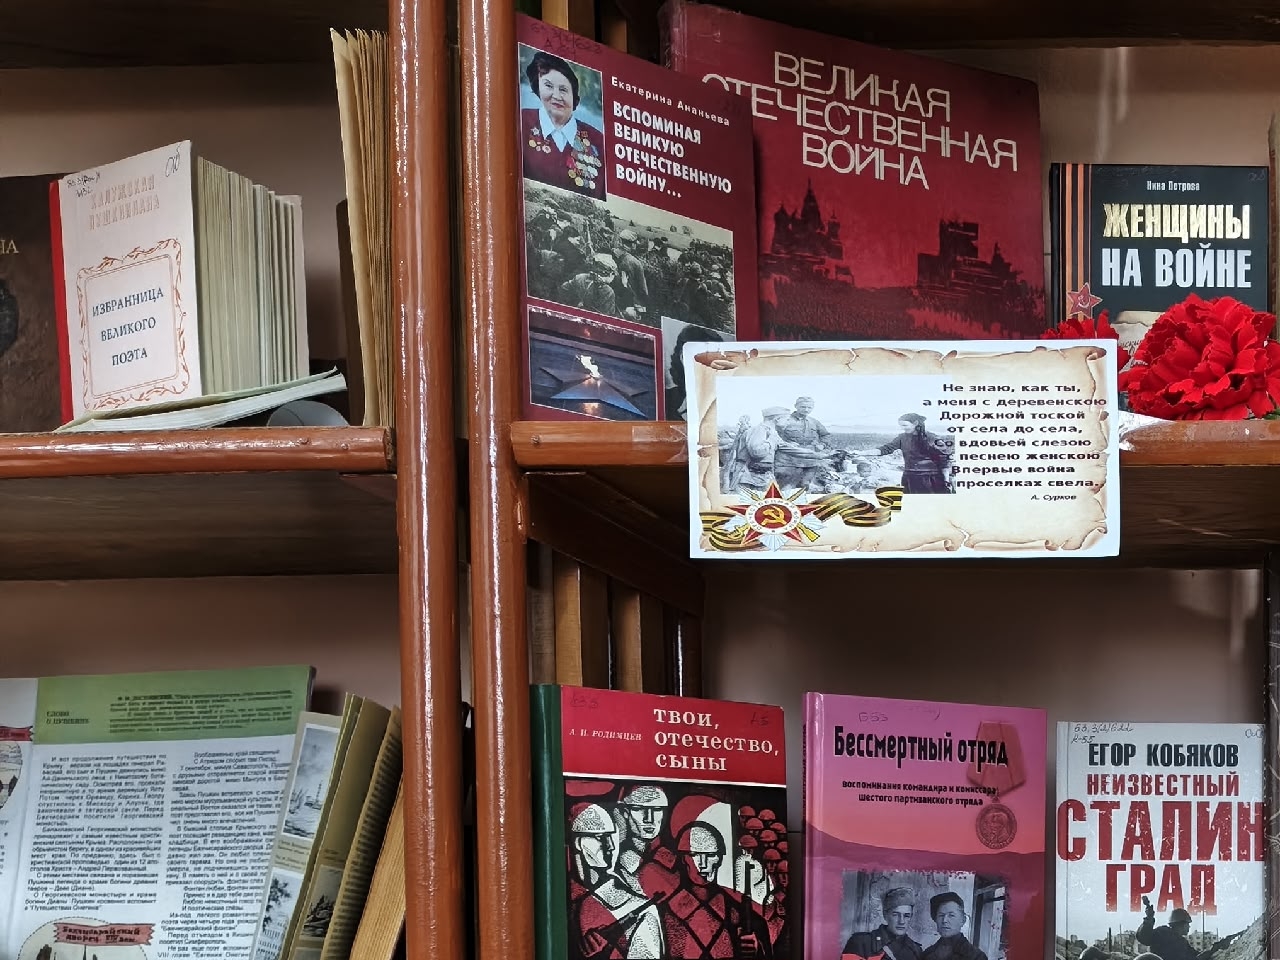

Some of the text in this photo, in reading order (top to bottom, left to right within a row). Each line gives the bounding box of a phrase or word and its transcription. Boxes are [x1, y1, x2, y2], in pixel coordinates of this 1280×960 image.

[774, 51, 950, 122] ВЕЛИКАЯ
[611, 76, 730, 126] Екатерина Ананьева
[613, 101, 702, 144] ВСПОМИНАЯ
[614, 122, 685, 158] ВЕЛИКУЮ
[614, 143, 732, 193] ОТЕЧЕСТВЕННУЮ
[803, 131, 930, 190] ВОЙНА
[1146, 180, 1201, 192] Нина Петрова
[1103, 202, 1251, 243] ЖЕНЩИНЫ
[1101, 243, 1252, 289] НА ВОЙНЕ
[92, 286, 164, 317] ИЗБРАННИЦА
[100, 316, 156, 342] ВЕЛИКОГО
[112, 347, 148, 366] ПОЭТА
[969, 385, 1015, 393] знаю,
[996, 399, 1107, 408] деревенскою
[939, 411, 1085, 421] Дорожной тоской
[1039, 426, 1083, 434] села,
[959, 438, 1026, 448] вдовьей
[959, 453, 1101, 461] песнею женскою
[951, 465, 1075, 475] Впервые война
[956, 479, 1099, 489] проселках свела.
[592, 730, 643, 741] РОДИМЦЕВ
[834, 726, 1008, 773] Бессмертный отряд
[1089, 743, 1239, 767] ЕГОР КОБЯКОВ
[842, 780, 948, 794] воспоминания командира
[1087, 771, 1240, 796] НЕИЗВЕСТНЫЙ
[858, 793, 984, 808] шестого партизанского отряда
[1057, 799, 1265, 862] СТАЛИН
[1105, 863, 1218, 914] ГРАД
